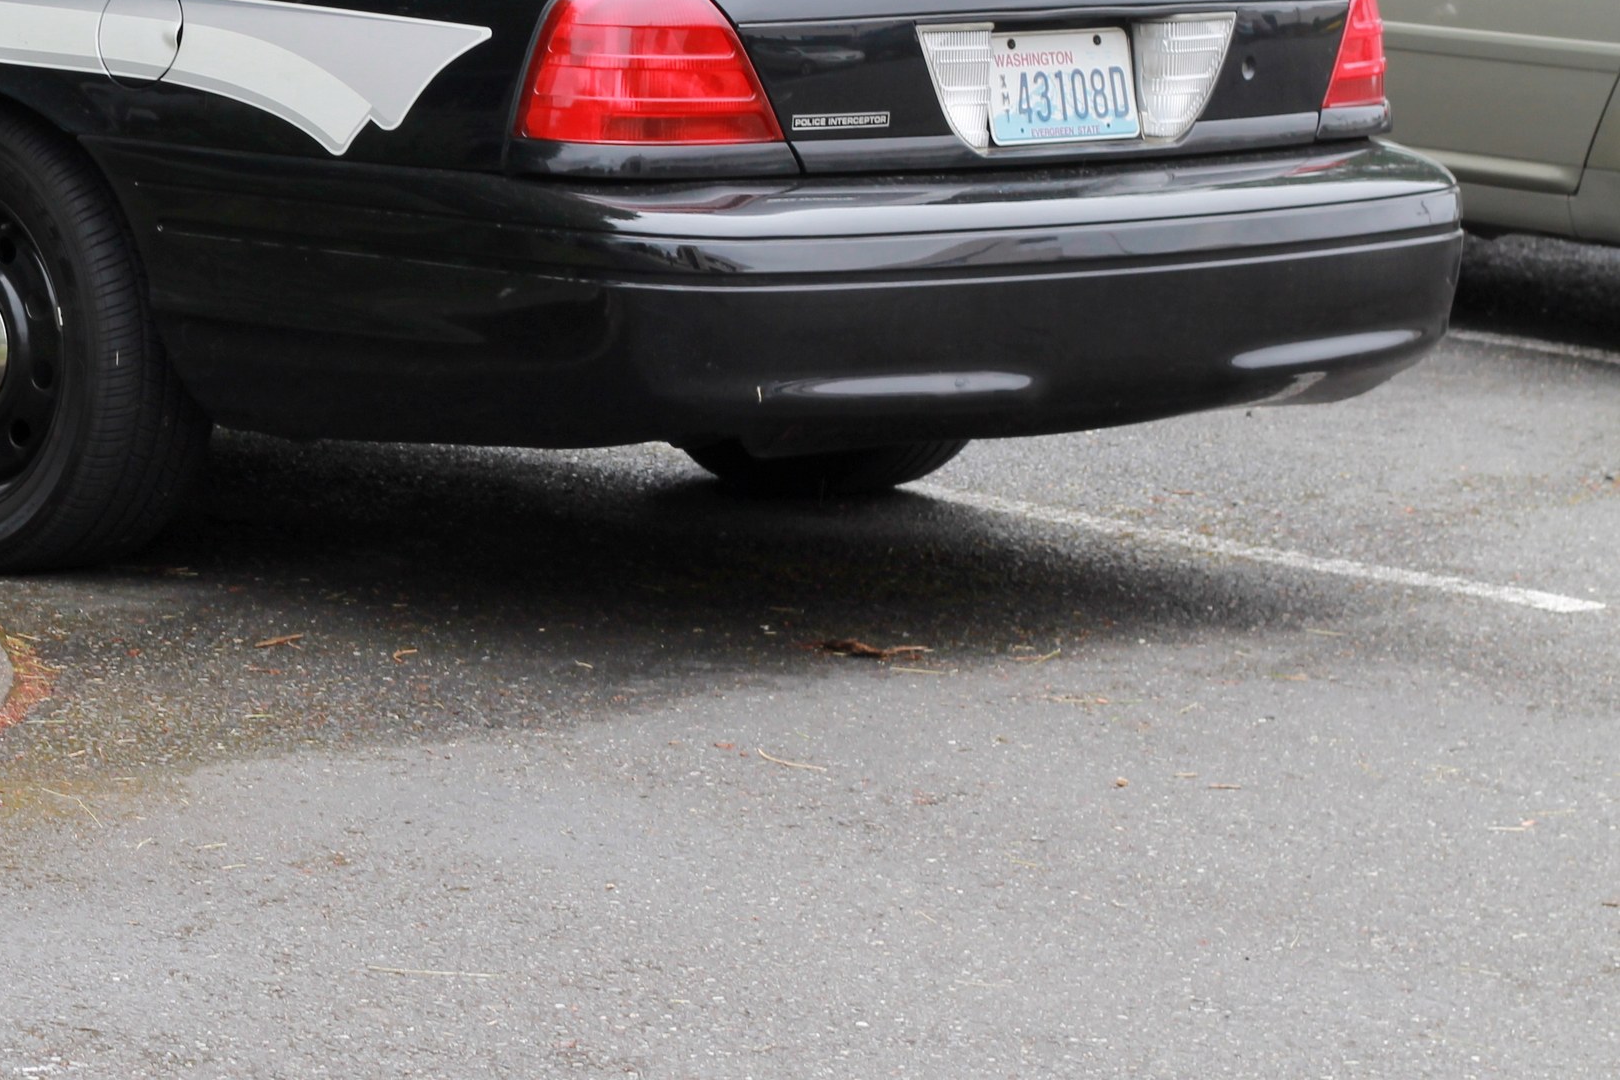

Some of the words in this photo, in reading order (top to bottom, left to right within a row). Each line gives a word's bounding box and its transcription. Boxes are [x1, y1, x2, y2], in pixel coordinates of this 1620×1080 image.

[994, 51, 1074, 68] WASHINGTON
[1018, 66, 1130, 123] 43108D
[794, 117, 827, 127] POLICE
[828, 115, 887, 126] INTERCEPTOR
[1031, 126, 1075, 137] EVERGREEN
[1078, 125, 1101, 135] STATE
